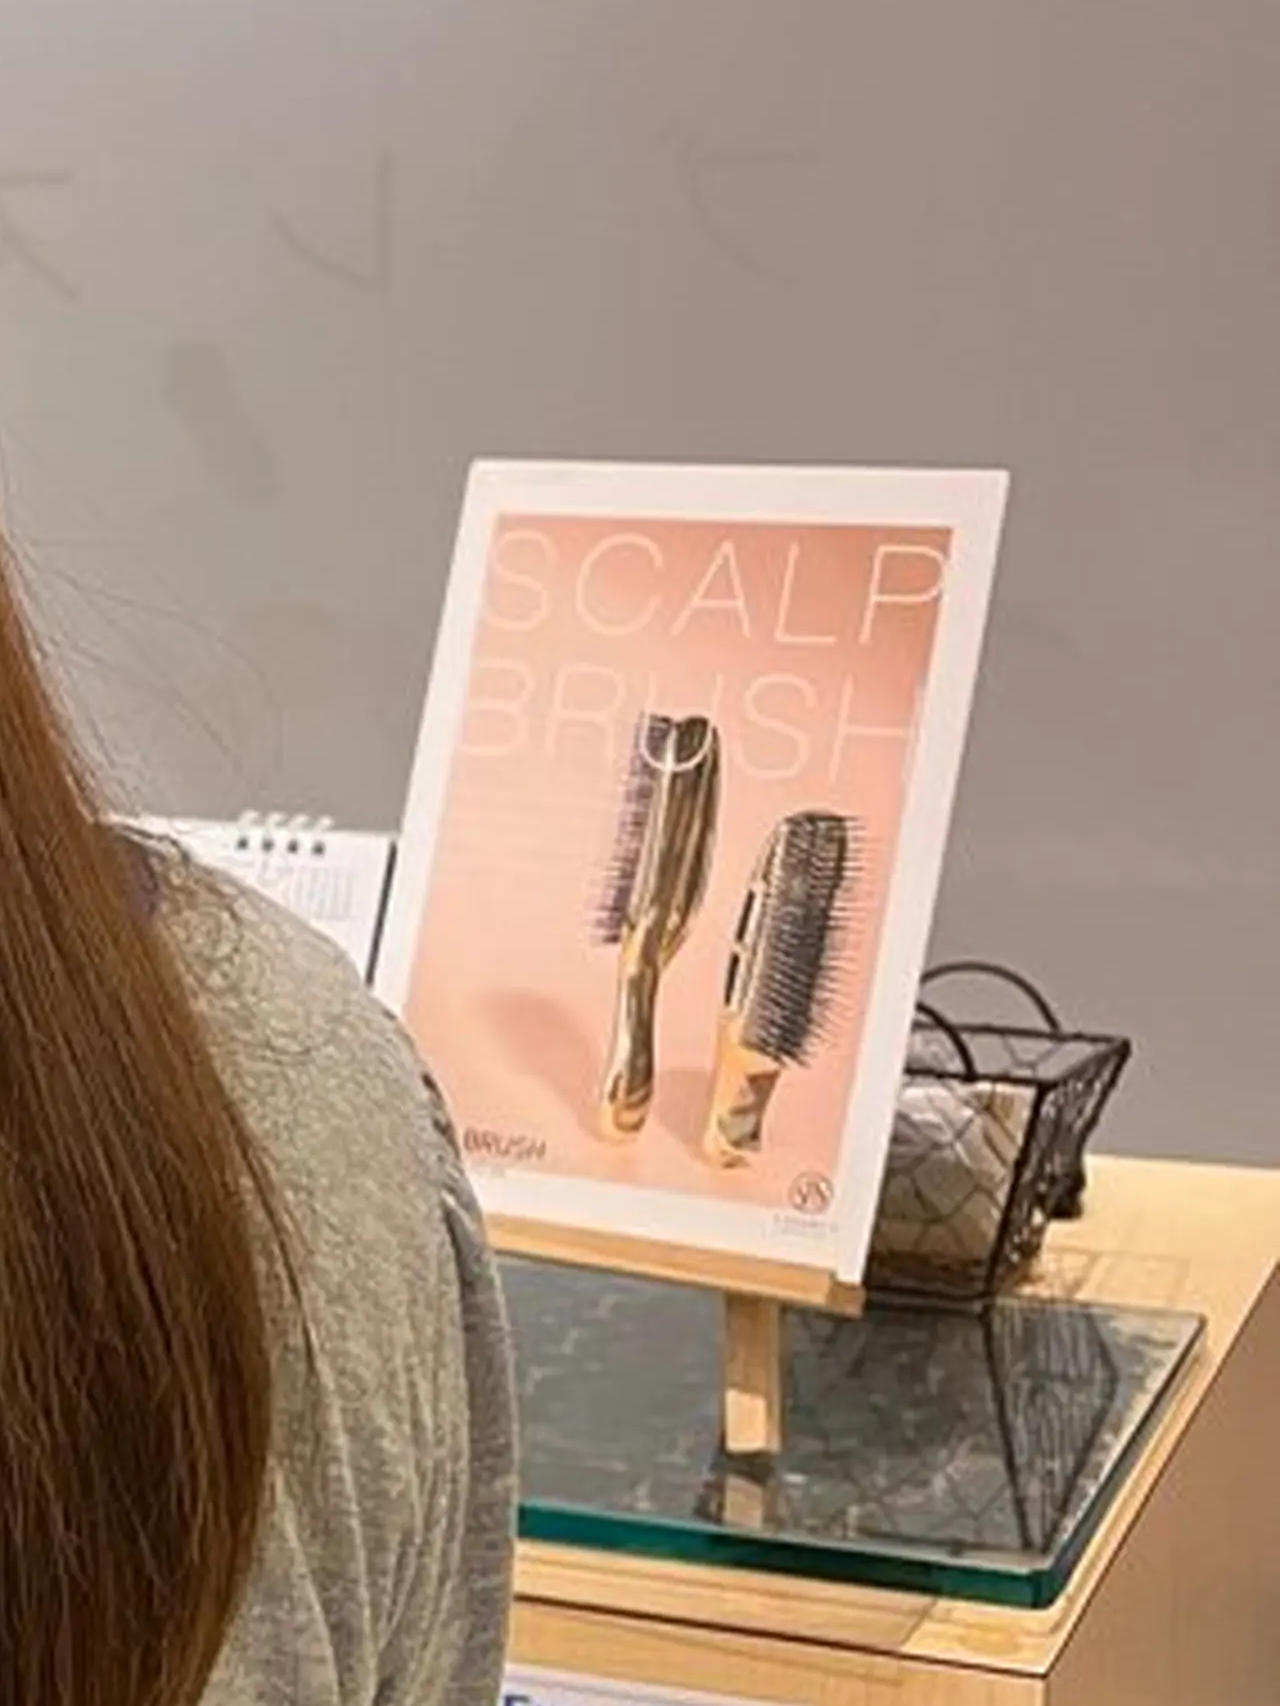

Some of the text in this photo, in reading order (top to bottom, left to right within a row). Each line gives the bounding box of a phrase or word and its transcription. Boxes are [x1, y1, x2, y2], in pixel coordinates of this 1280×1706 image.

[485, 529, 951, 645] SCALP
[455, 657, 923, 786] BRUSH
[463, 1126, 547, 1162] BRUSH
